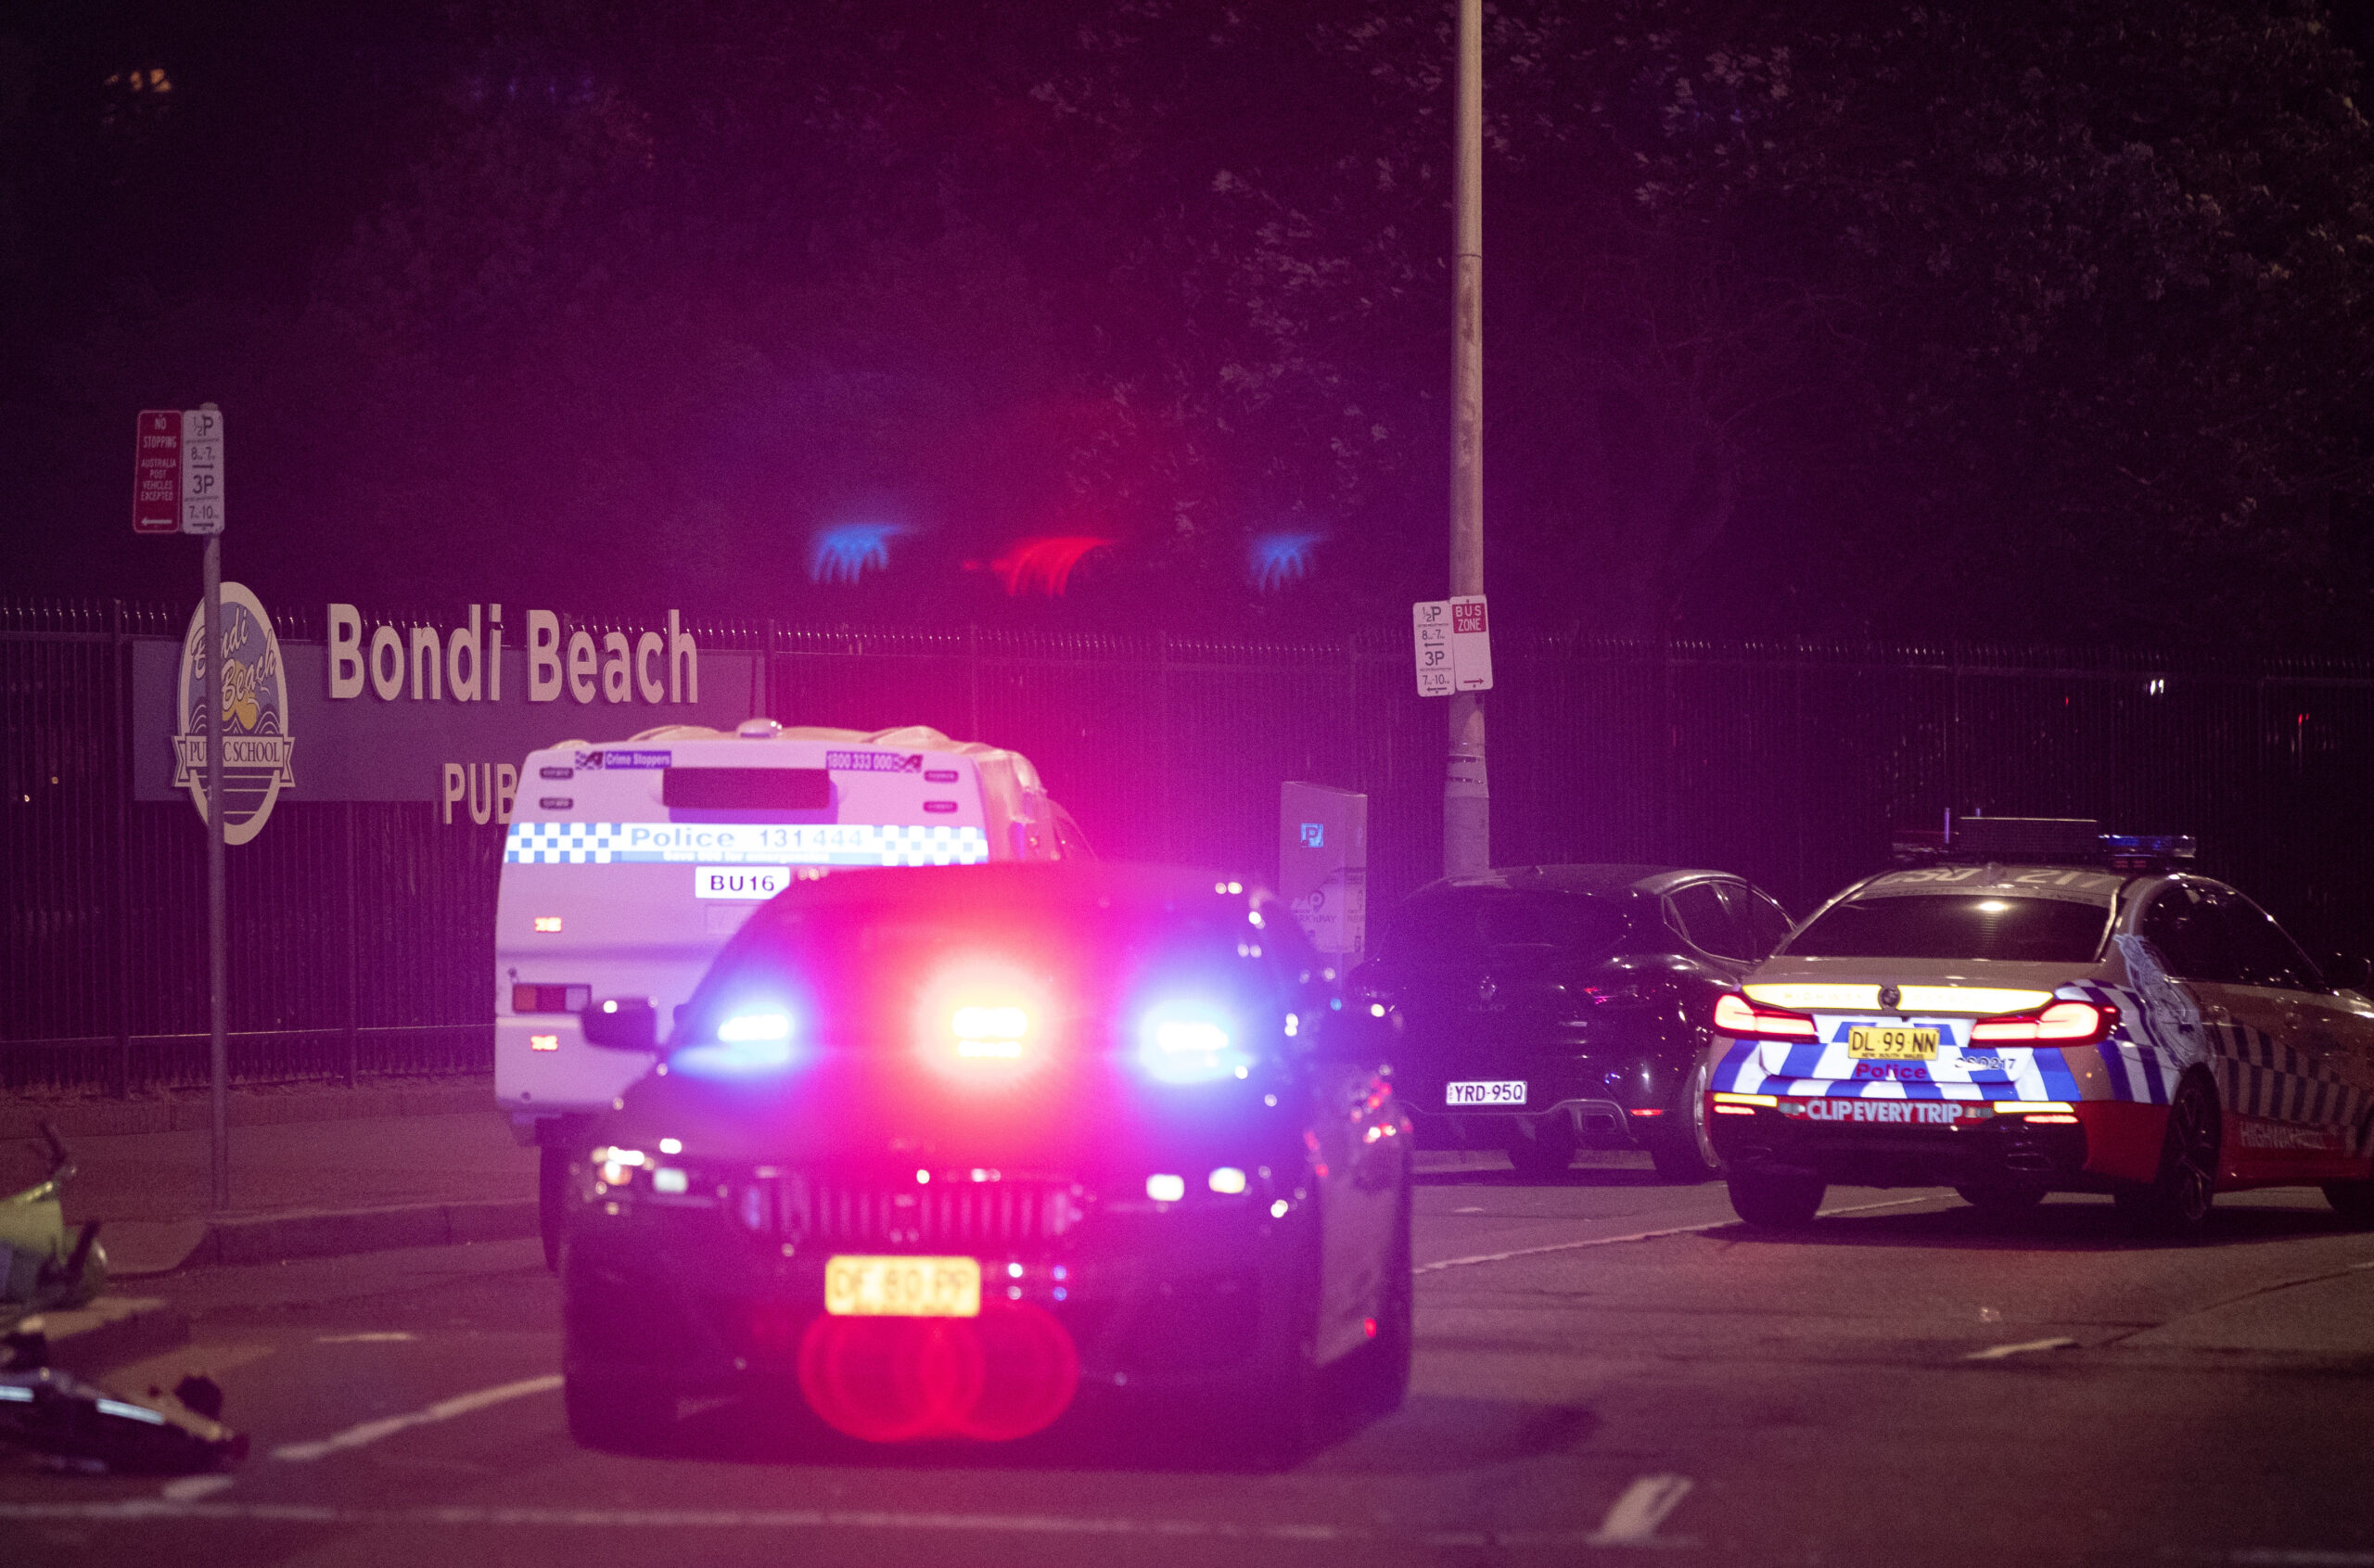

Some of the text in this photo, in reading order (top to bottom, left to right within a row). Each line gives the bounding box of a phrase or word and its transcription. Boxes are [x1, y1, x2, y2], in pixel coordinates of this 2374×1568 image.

[155, 417, 166, 430] NO
[144, 436, 176, 448] STOPPING
[141, 458, 176, 468] AUSTRALIA
[149, 469, 167, 479] POST
[143, 480, 173, 491] VEHICLES
[193, 475, 214, 494] 3P
[1456, 605, 1482, 618] BUS
[1458, 618, 1482, 631] ZONE
[191, 606, 249, 680] Bndi
[327, 603, 698, 704] Bondi Beach
[1424, 651, 1445, 666] 3P
[221, 629, 277, 710] Beach
[189, 741, 281, 762] PUC SCHOOL
[606, 753, 670, 767] Crime Stoppers
[853, 753, 871, 769] 333
[631, 827, 862, 848] Police 131 444
[709, 874, 775, 892] BU16
[1852, 1031, 1935, 1053] DL 99 NN
[1856, 1063, 1927, 1079] Police
[1806, 1100, 1963, 1124] CLIP EVERY TRIP
